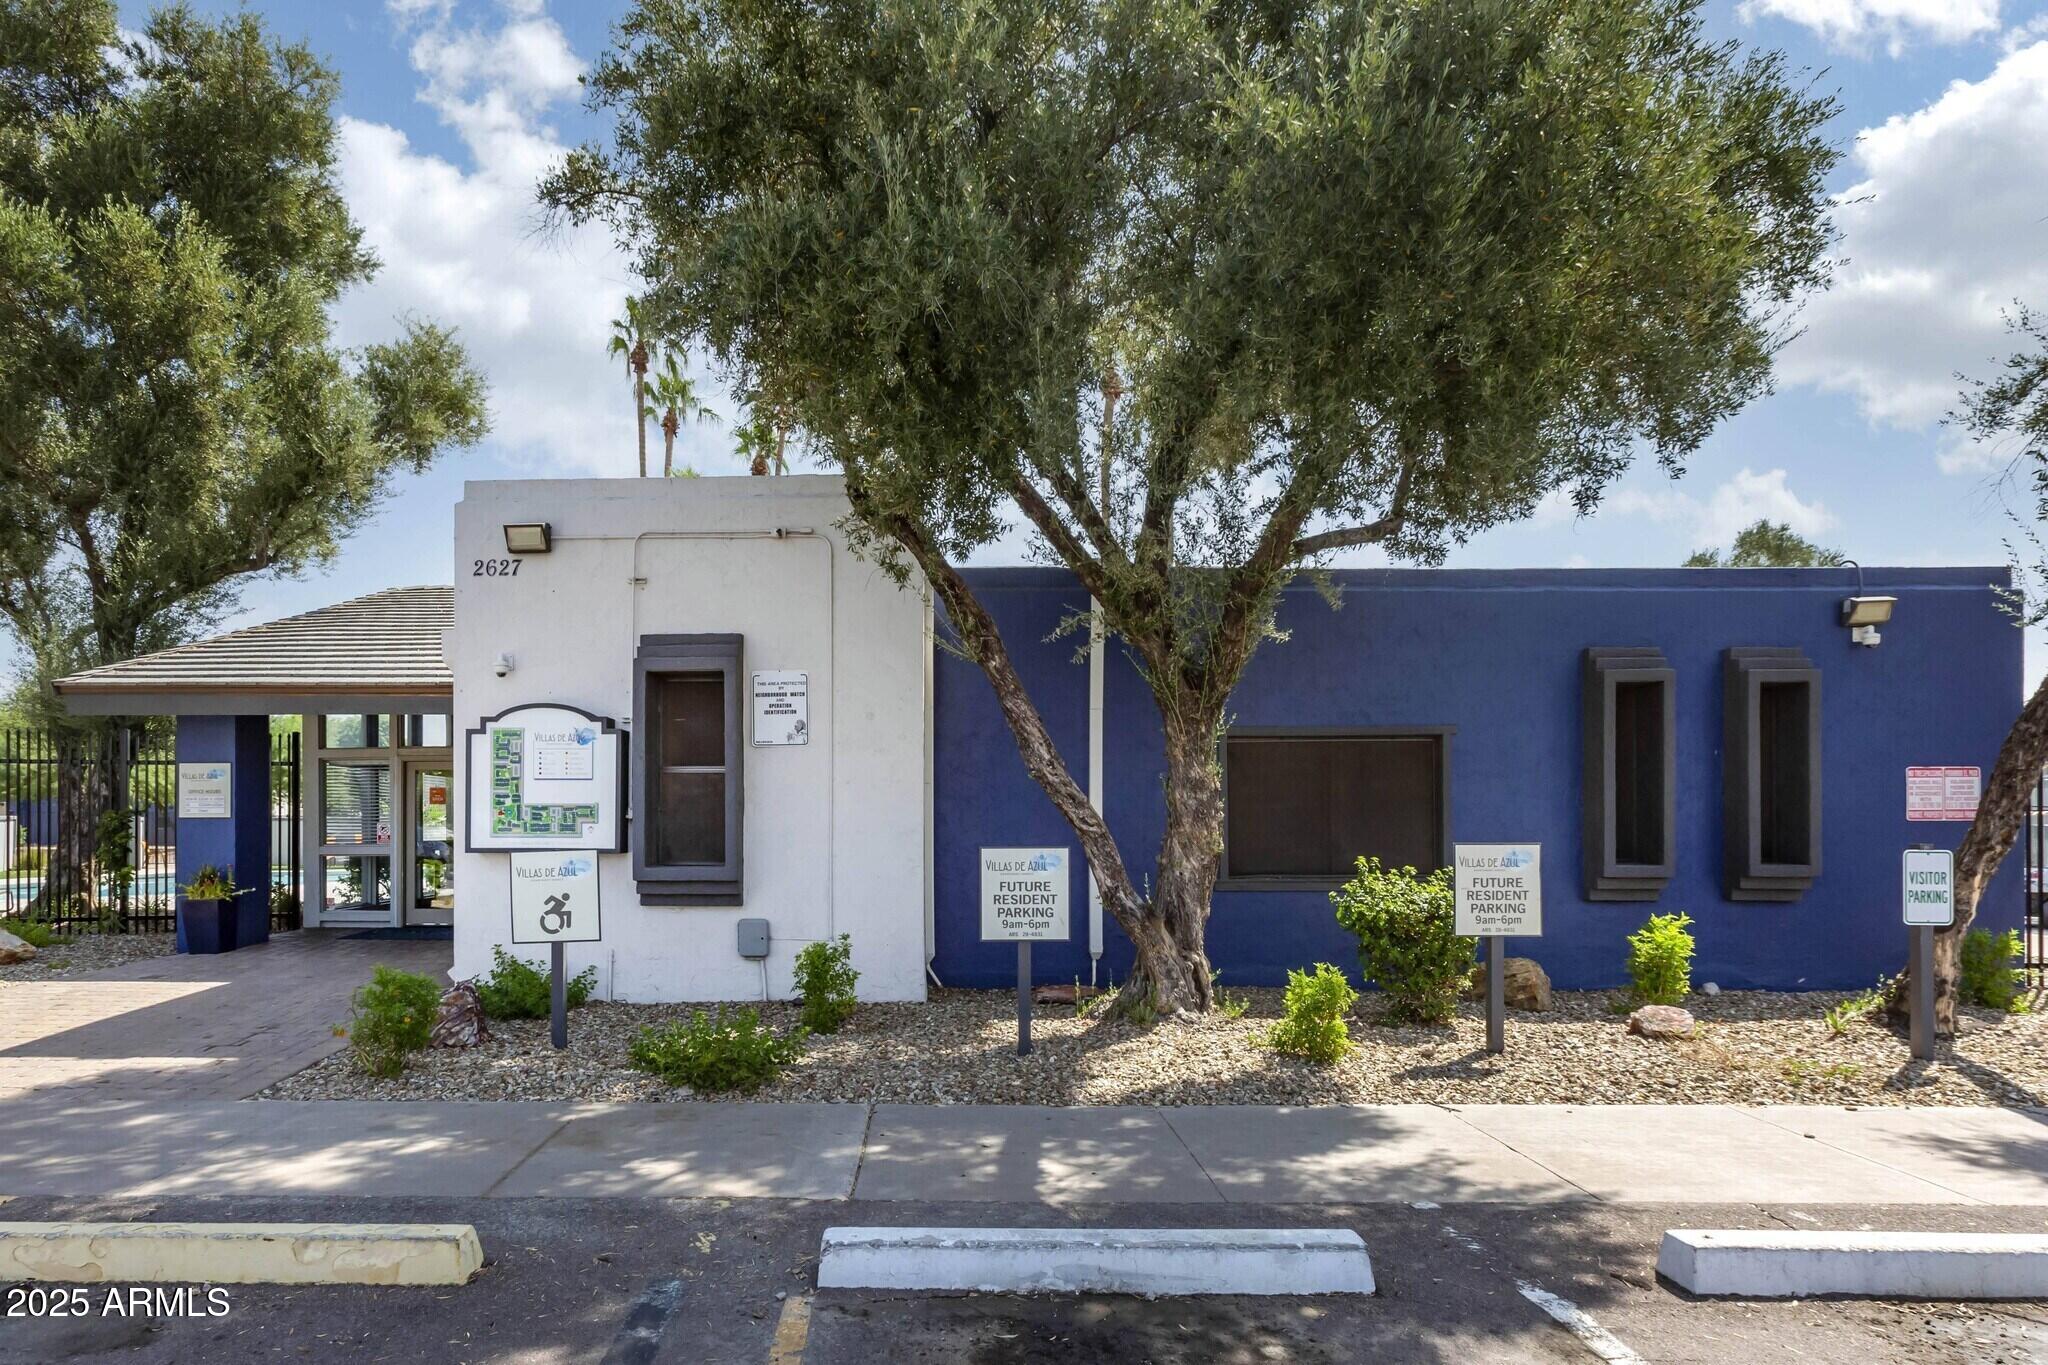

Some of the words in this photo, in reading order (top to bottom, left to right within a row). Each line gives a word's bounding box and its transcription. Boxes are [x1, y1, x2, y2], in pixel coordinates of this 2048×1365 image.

[473, 559, 523, 576] 2627
[535, 731, 556, 742] VILLAS
[557, 733, 566, 742] DE
[985, 859, 1012, 871] VILLAS
[1014, 861, 1026, 871] DE
[1027, 860, 1048, 871] AZUL
[1459, 855, 1486, 868] VILLAS
[1487, 857, 1499, 868] DE
[1500, 856, 1521, 868] AZUL
[516, 866, 543, 878] VILLAS
[544, 867, 556, 878] DE
[557, 865, 578, 877] AZUL
[1472, 877, 1524, 889] FUTURE
[1909, 871, 1947, 885] VISITOR
[999, 881, 1052, 892] FUTURE
[993, 894, 1058, 905] RESIDENT
[1466, 890, 1529, 901] RESIDENT
[1907, 890, 1948, 904] PARKING
[997, 907, 1054, 918] PARKING
[1470, 903, 1526, 914] PARKING
[1001, 919, 1050, 930] 9am-6pm
[1475, 914, 1522, 926] 9am-6pm
